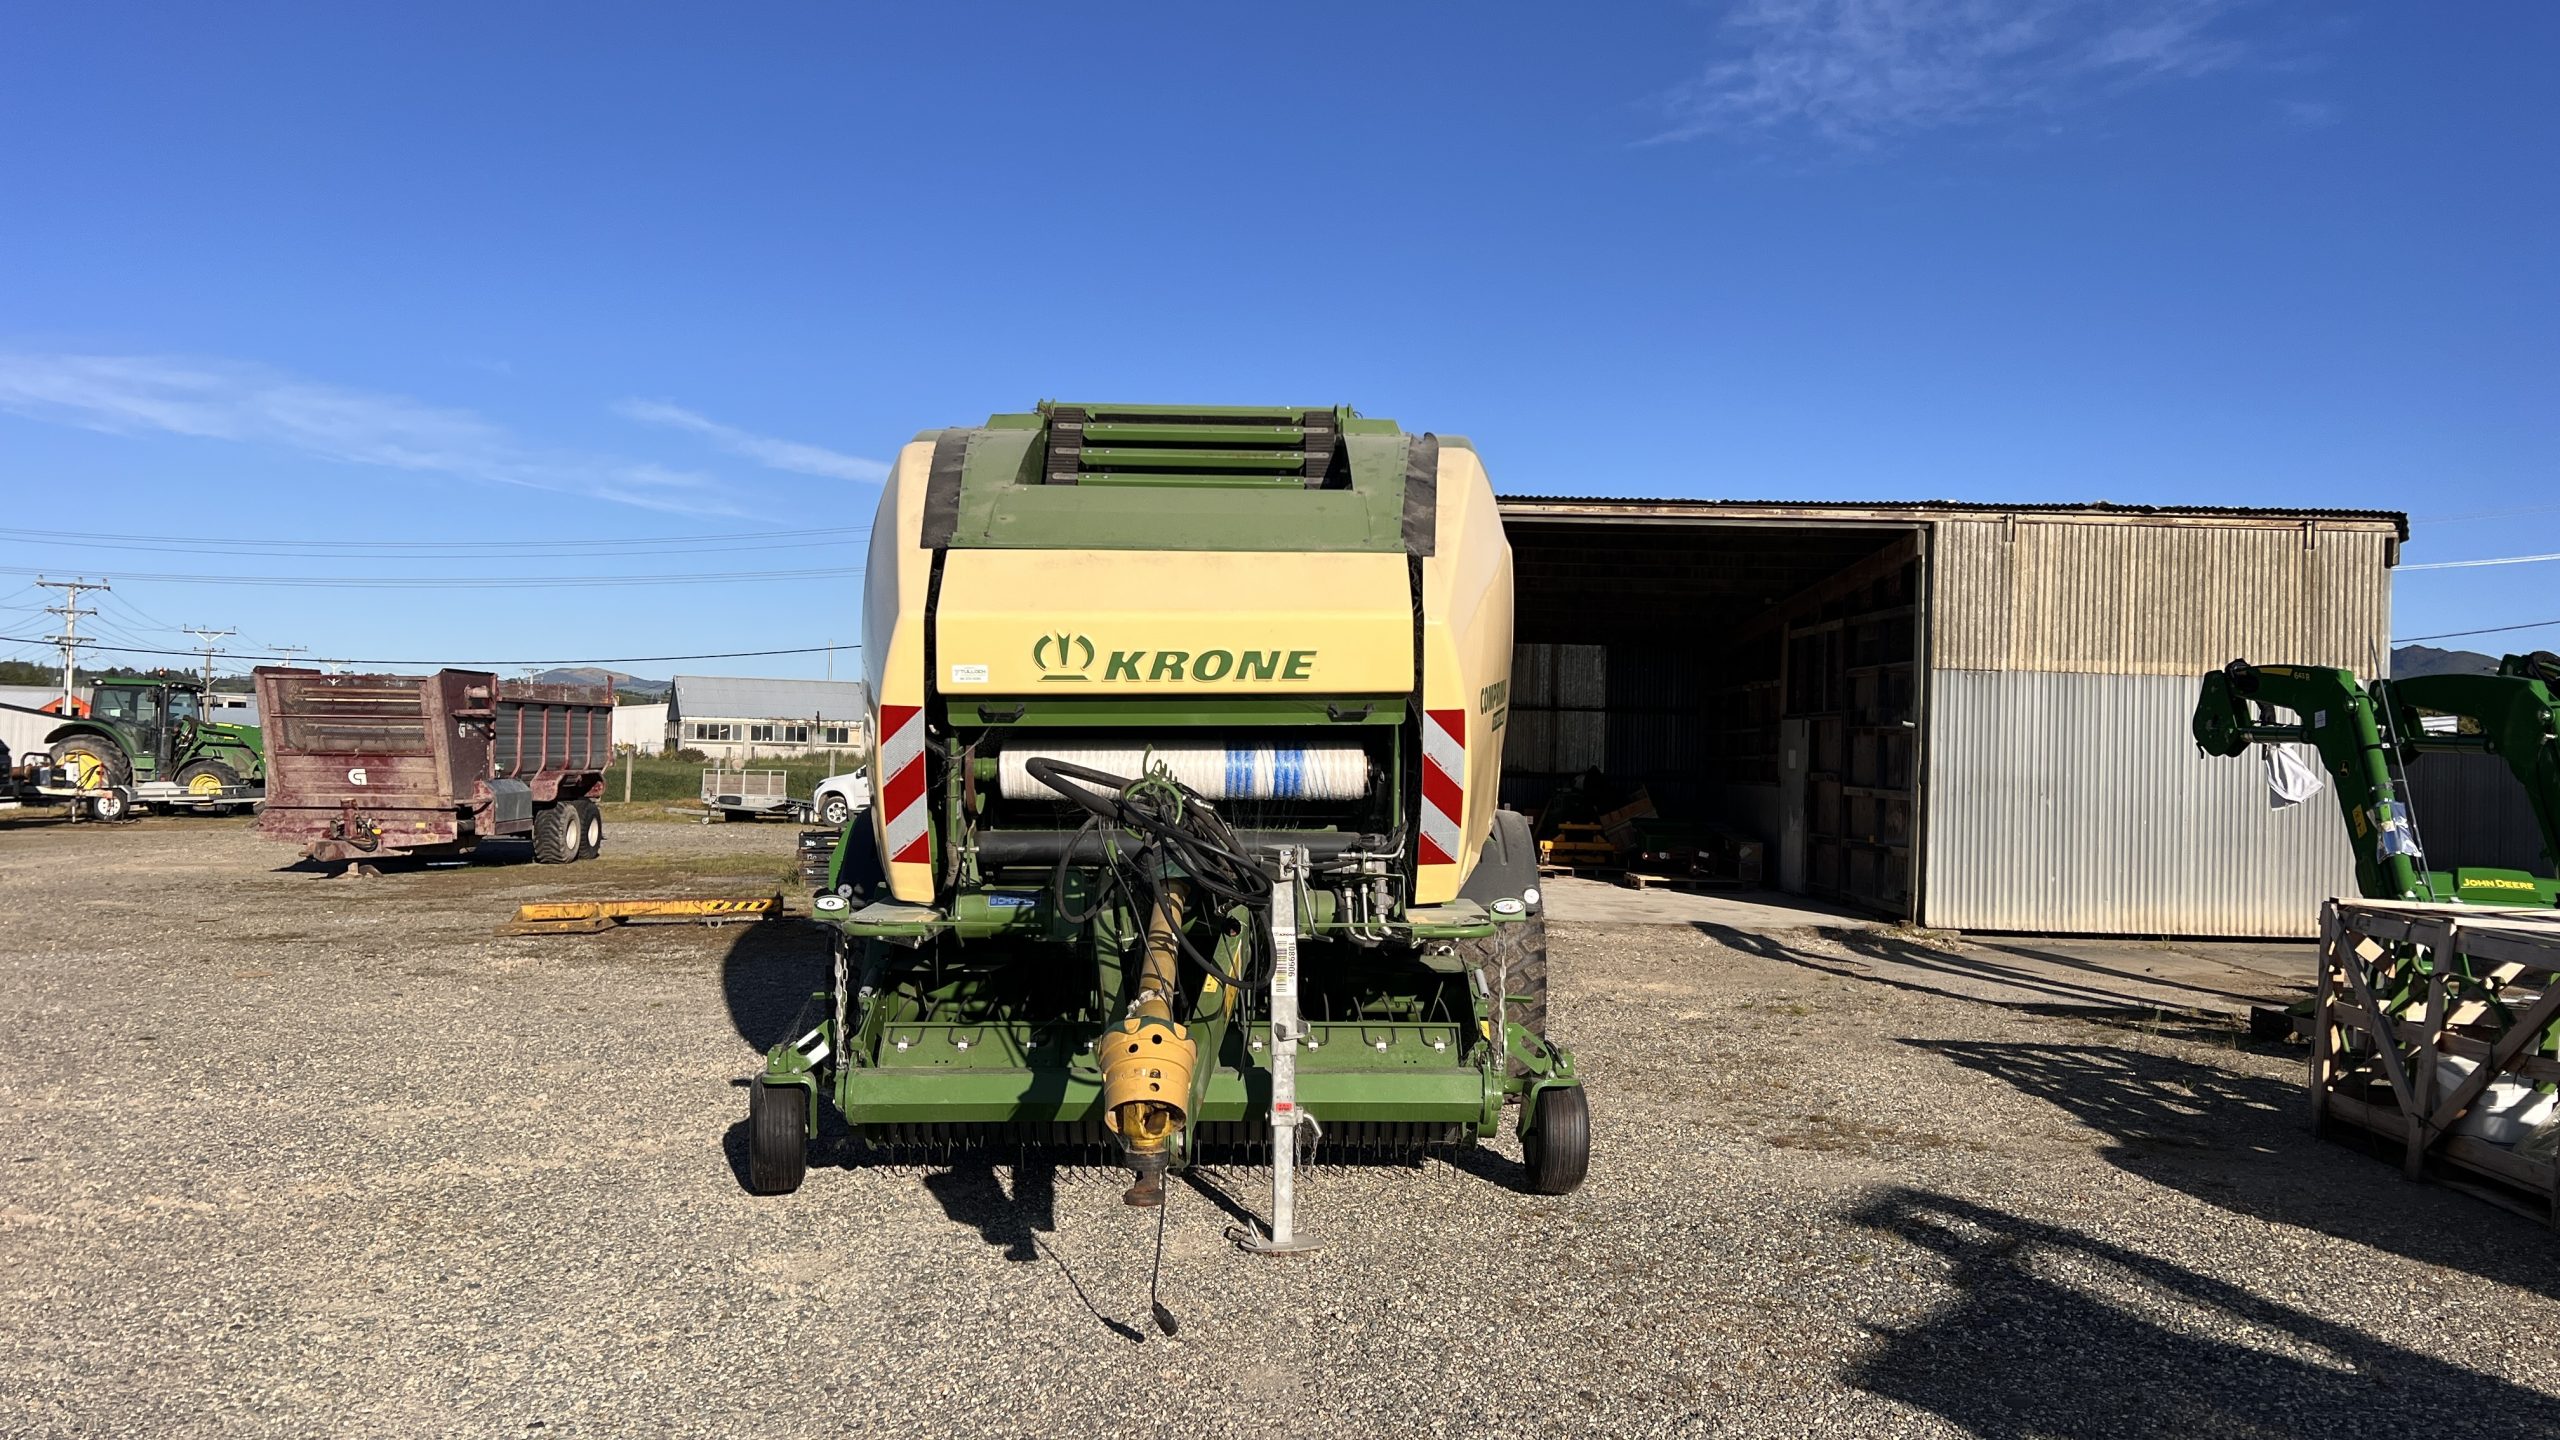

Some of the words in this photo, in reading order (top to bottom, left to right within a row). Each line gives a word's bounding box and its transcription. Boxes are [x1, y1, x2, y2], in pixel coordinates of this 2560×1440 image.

[1102, 649, 1318, 681] KRONE
[2463, 878, 2494, 888] JOHN
[2495, 879, 2535, 890] DEERE
[1288, 942, 1296, 977] 1089906
